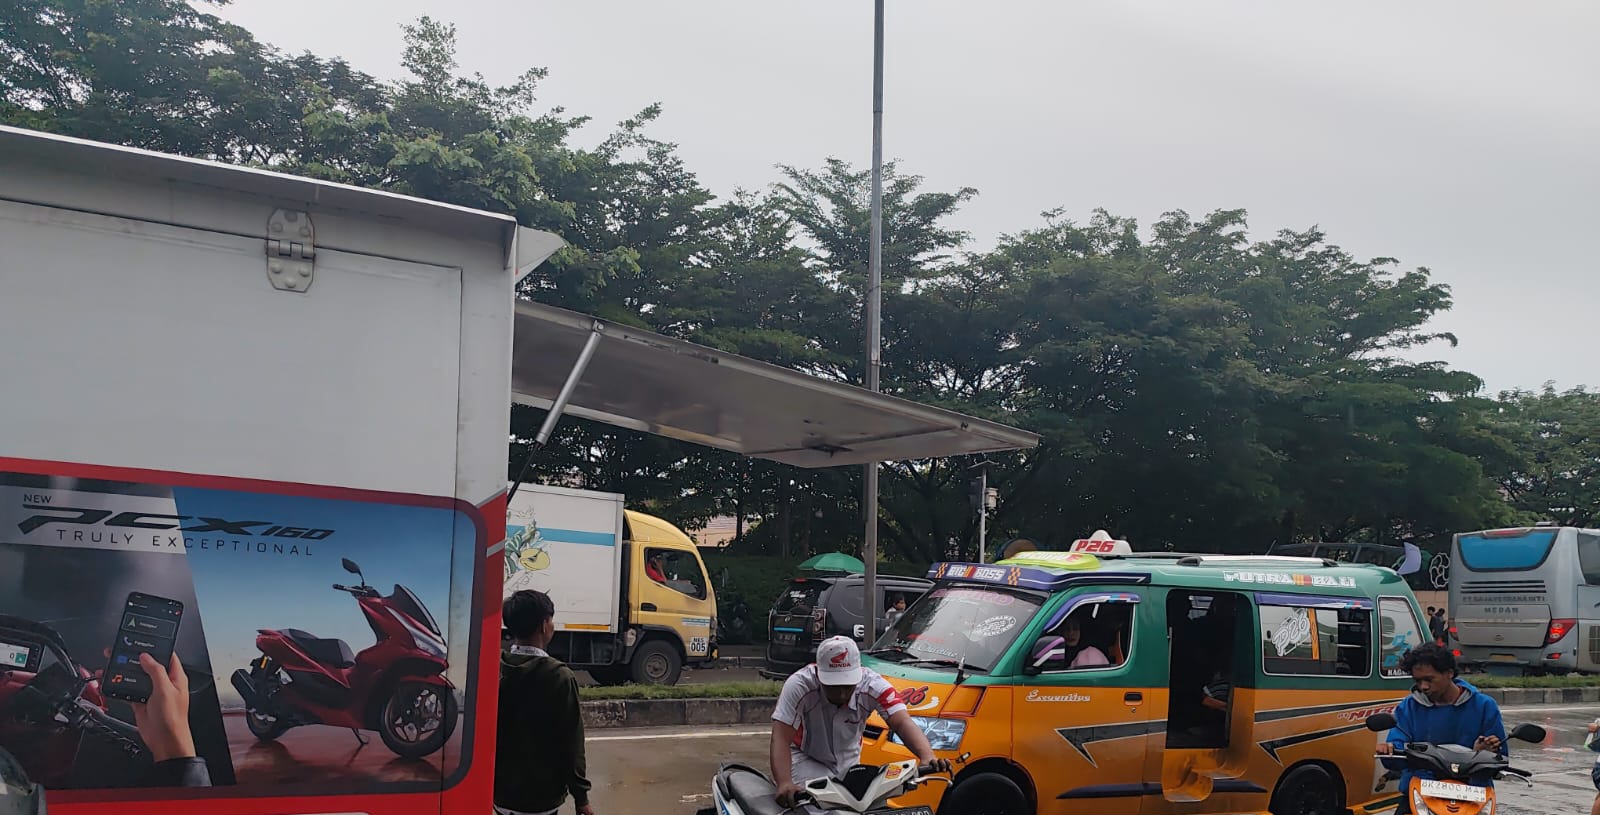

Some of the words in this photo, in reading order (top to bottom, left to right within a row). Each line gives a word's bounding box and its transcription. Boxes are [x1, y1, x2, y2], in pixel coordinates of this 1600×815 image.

[23, 494, 51, 504] NEW
[17, 504, 272, 535] PCX
[260, 525, 335, 541] 160
[56, 529, 134, 544] TRULY
[152, 535, 313, 556] EXCEPTIONAL
[1075, 540, 1117, 553] P26
[973, 566, 1007, 581] BOSS
[1272, 608, 1311, 656] P26
[690, 642, 706, 652] 005
[1025, 689, 1092, 702] Executive
[1347, 705, 1398, 722] NITR
